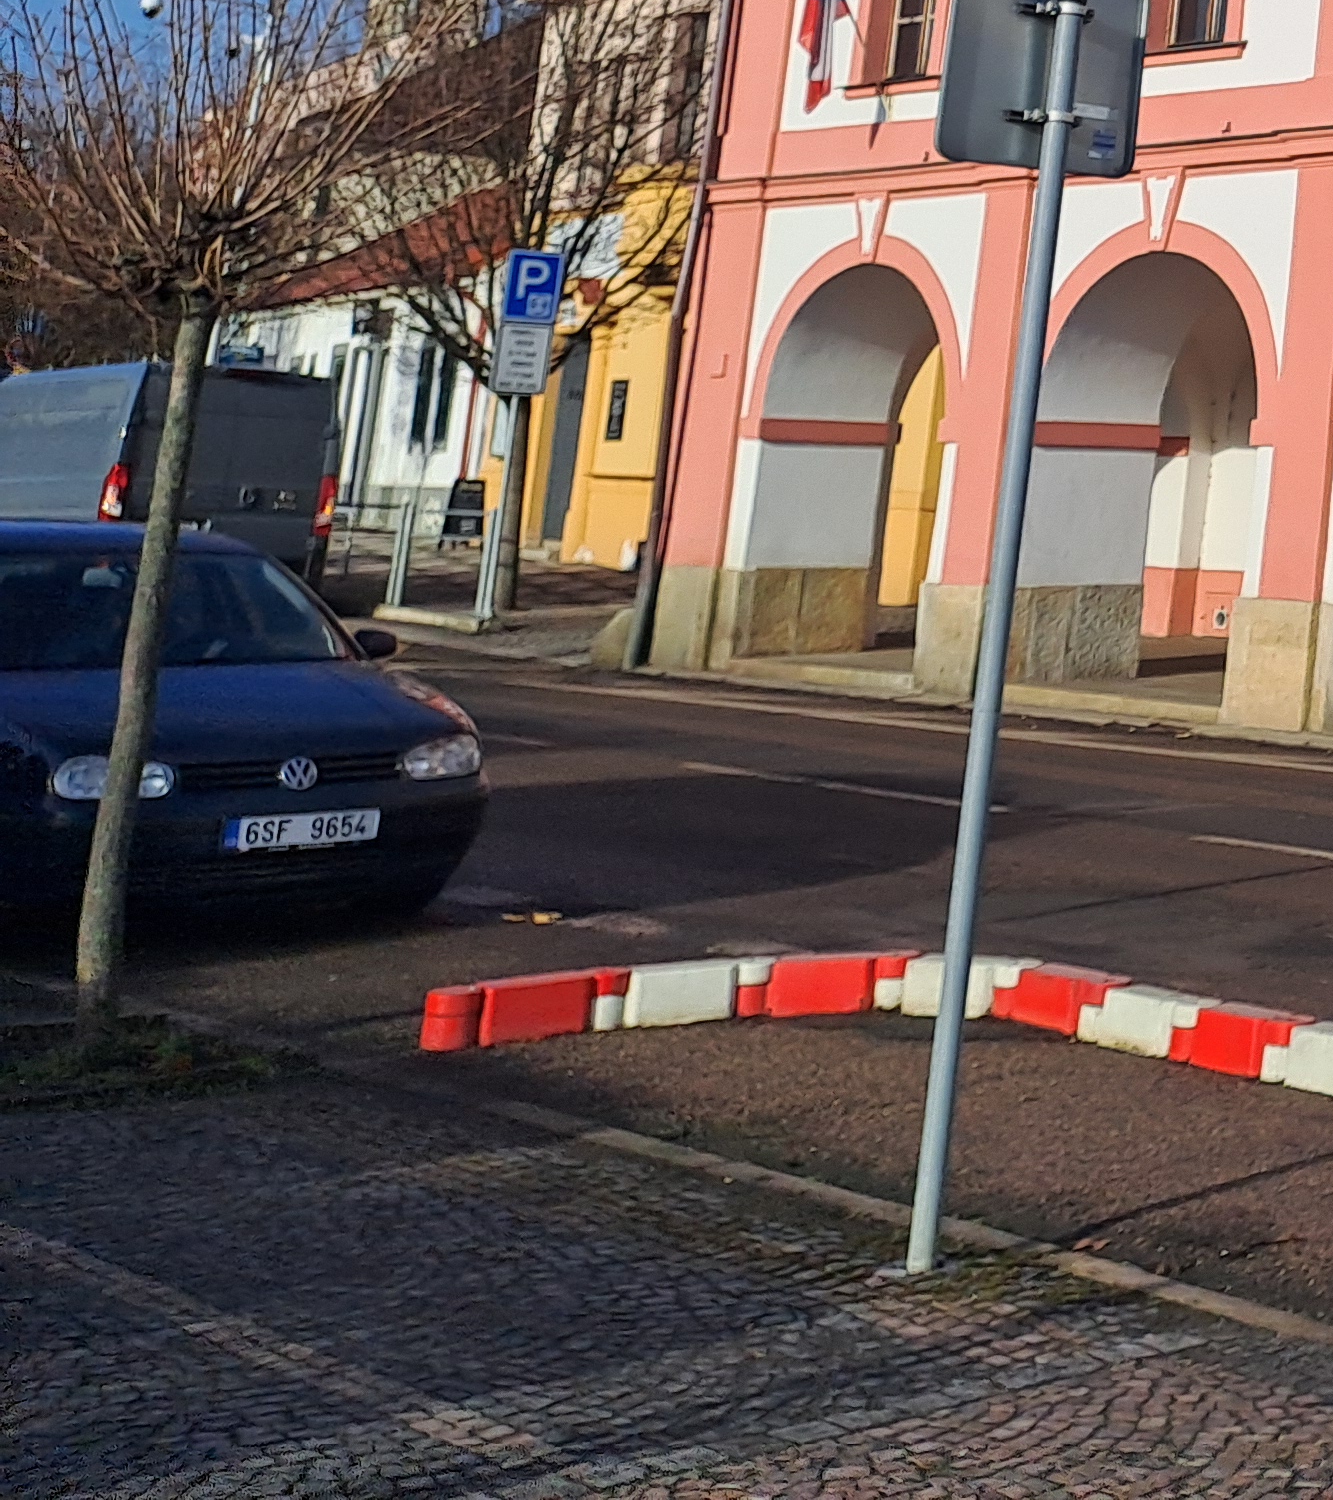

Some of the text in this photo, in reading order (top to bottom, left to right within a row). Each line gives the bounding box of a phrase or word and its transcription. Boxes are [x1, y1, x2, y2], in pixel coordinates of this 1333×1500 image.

[516, 259, 551, 300] P
[245, 814, 367, 845] 6SF 9654
